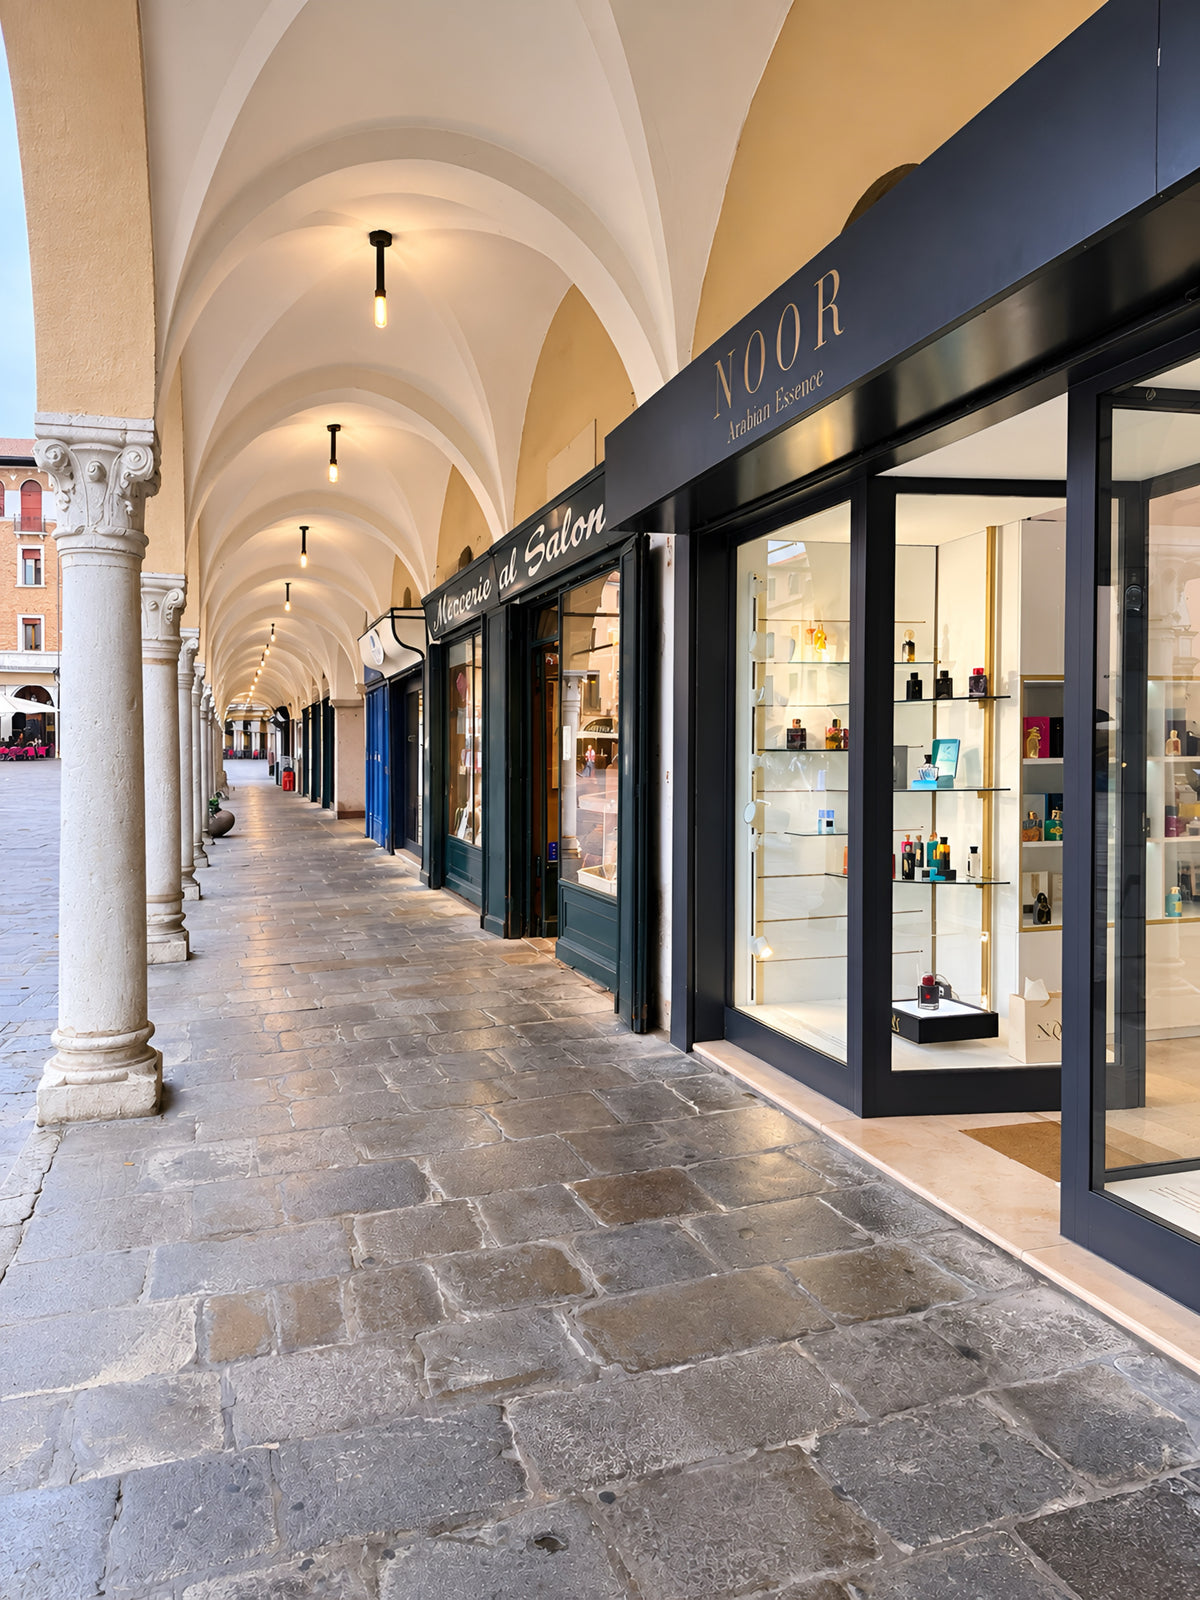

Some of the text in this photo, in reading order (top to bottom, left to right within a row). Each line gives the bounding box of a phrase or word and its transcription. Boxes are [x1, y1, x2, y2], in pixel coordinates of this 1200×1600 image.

[713, 269, 845, 420] NOOR
[727, 369, 824, 444] Arabian Essence
[499, 547, 517, 591] al
[524, 503, 606, 577] Salon
